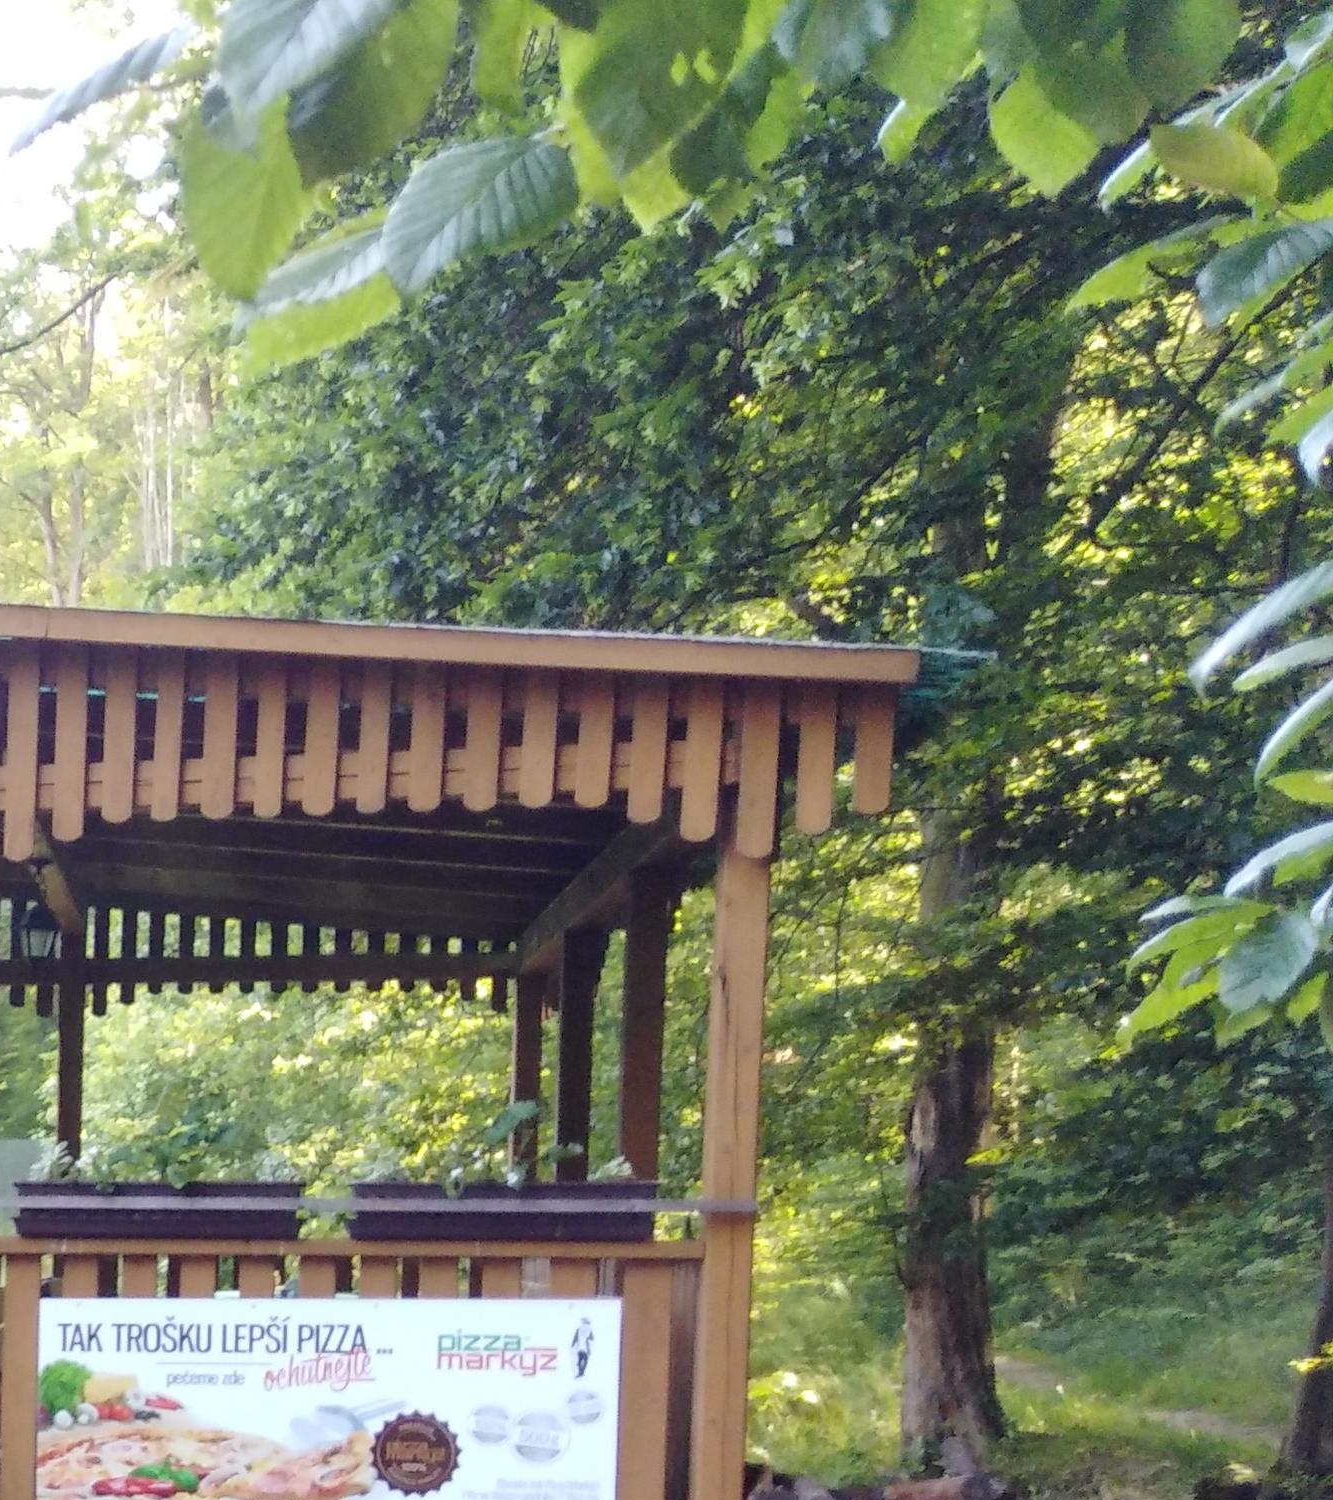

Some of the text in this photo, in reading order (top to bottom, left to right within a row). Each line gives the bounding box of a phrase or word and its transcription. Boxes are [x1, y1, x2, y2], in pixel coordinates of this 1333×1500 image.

[57, 1322, 104, 1353] TAK
[111, 1315, 214, 1354] TROŠKU
[221, 1315, 291, 1354] LEPŠÍ
[296, 1323, 368, 1355] PIZZA
[438, 1329, 522, 1352] pizza
[436, 1347, 558, 1377] markyz
[166, 1371, 245, 1388] pečeme zde
